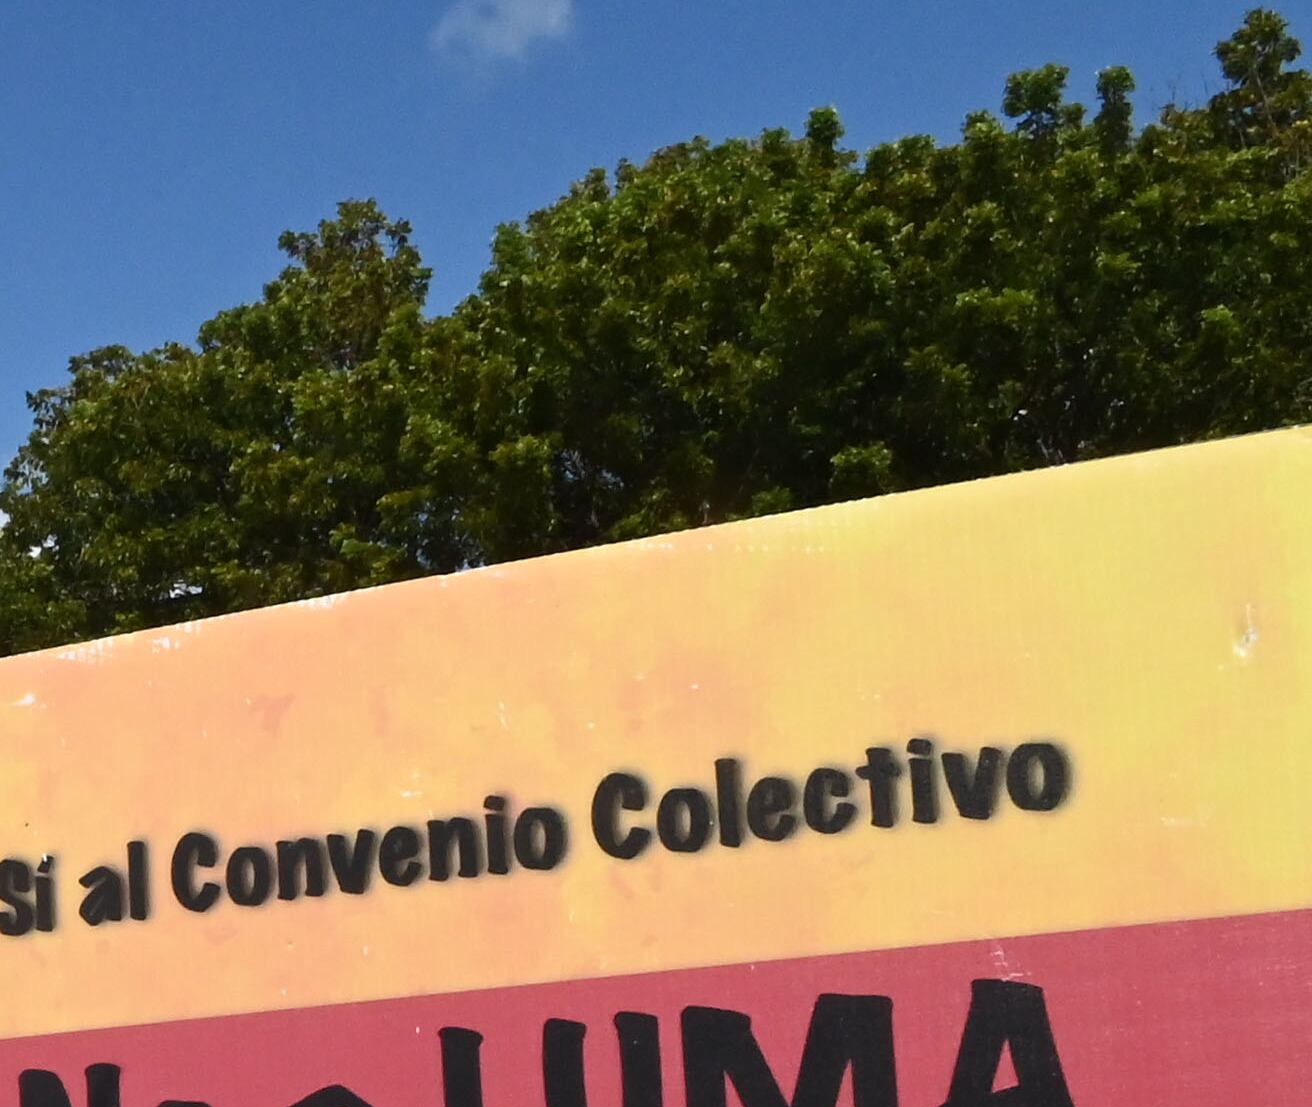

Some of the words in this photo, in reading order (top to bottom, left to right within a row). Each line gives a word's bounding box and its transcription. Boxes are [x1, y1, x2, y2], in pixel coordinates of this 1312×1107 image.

[79, 841, 149, 926] al
[171, 796, 566, 912] Convenio
[592, 739, 1068, 859] Colectivo
